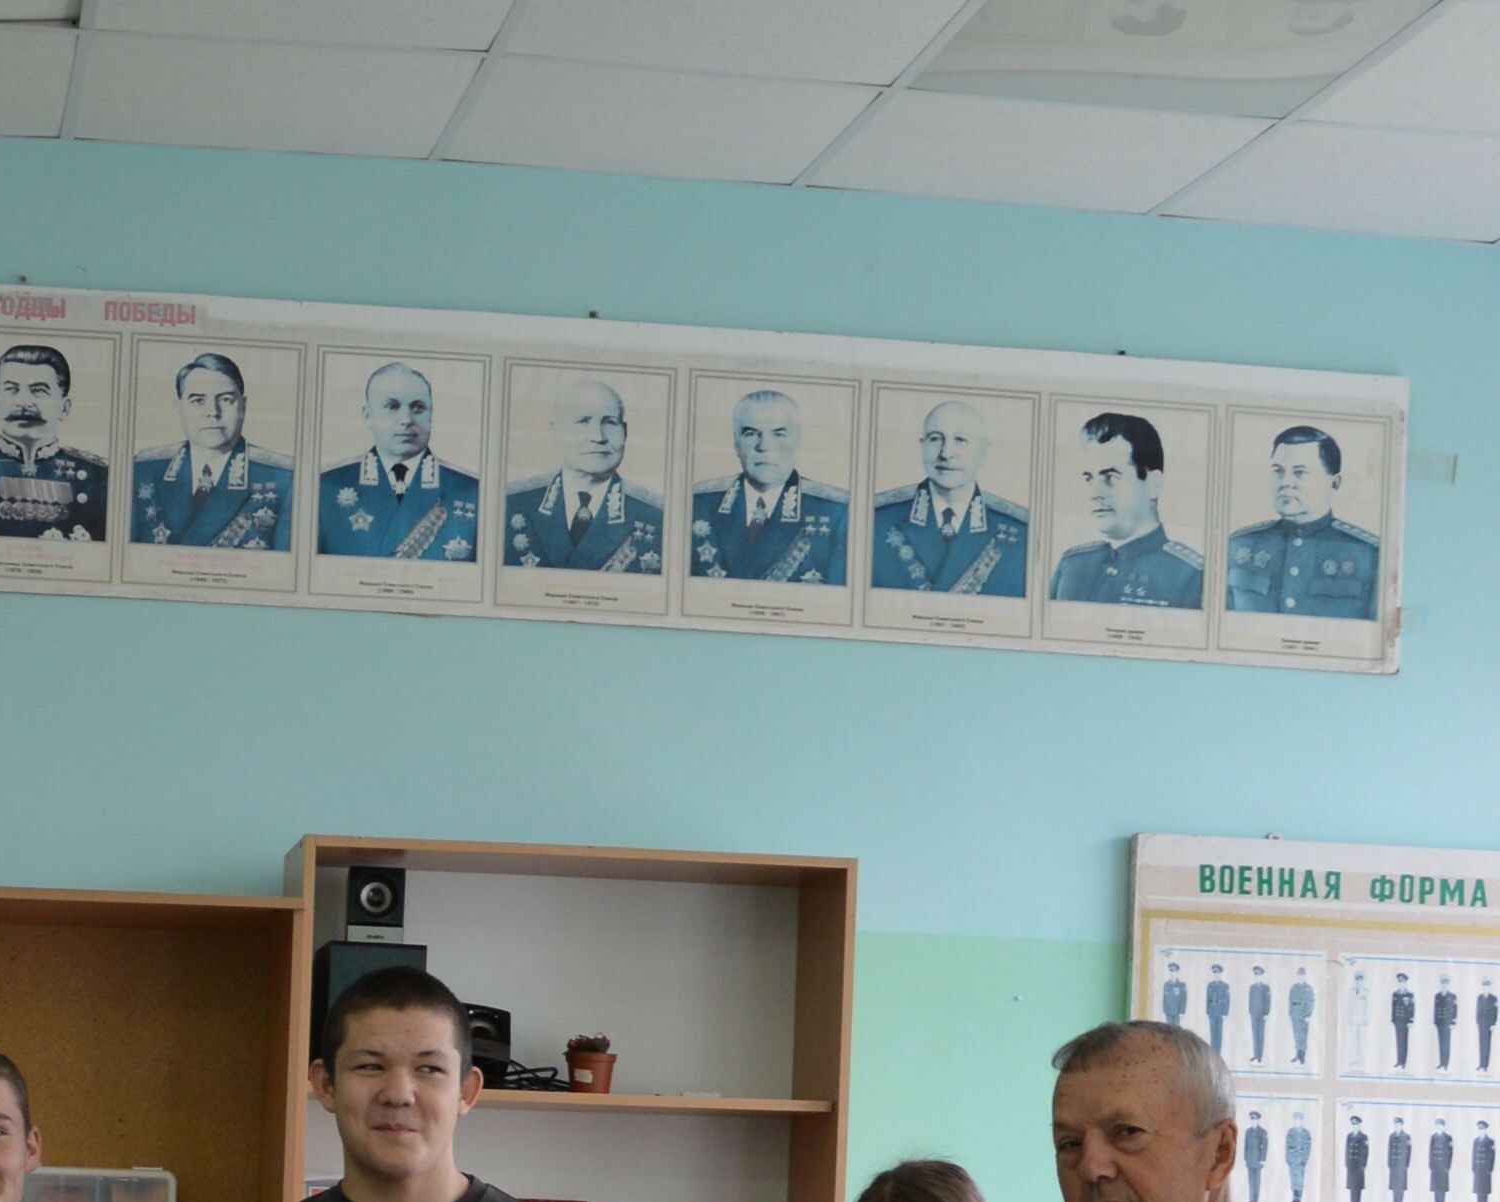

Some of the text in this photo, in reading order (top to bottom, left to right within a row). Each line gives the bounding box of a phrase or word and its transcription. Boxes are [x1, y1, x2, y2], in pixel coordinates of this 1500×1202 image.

[104, 300, 196, 327] ПОБЕДЫ
[1199, 864, 1488, 907] ВОЕННАЯ ФОРМА
